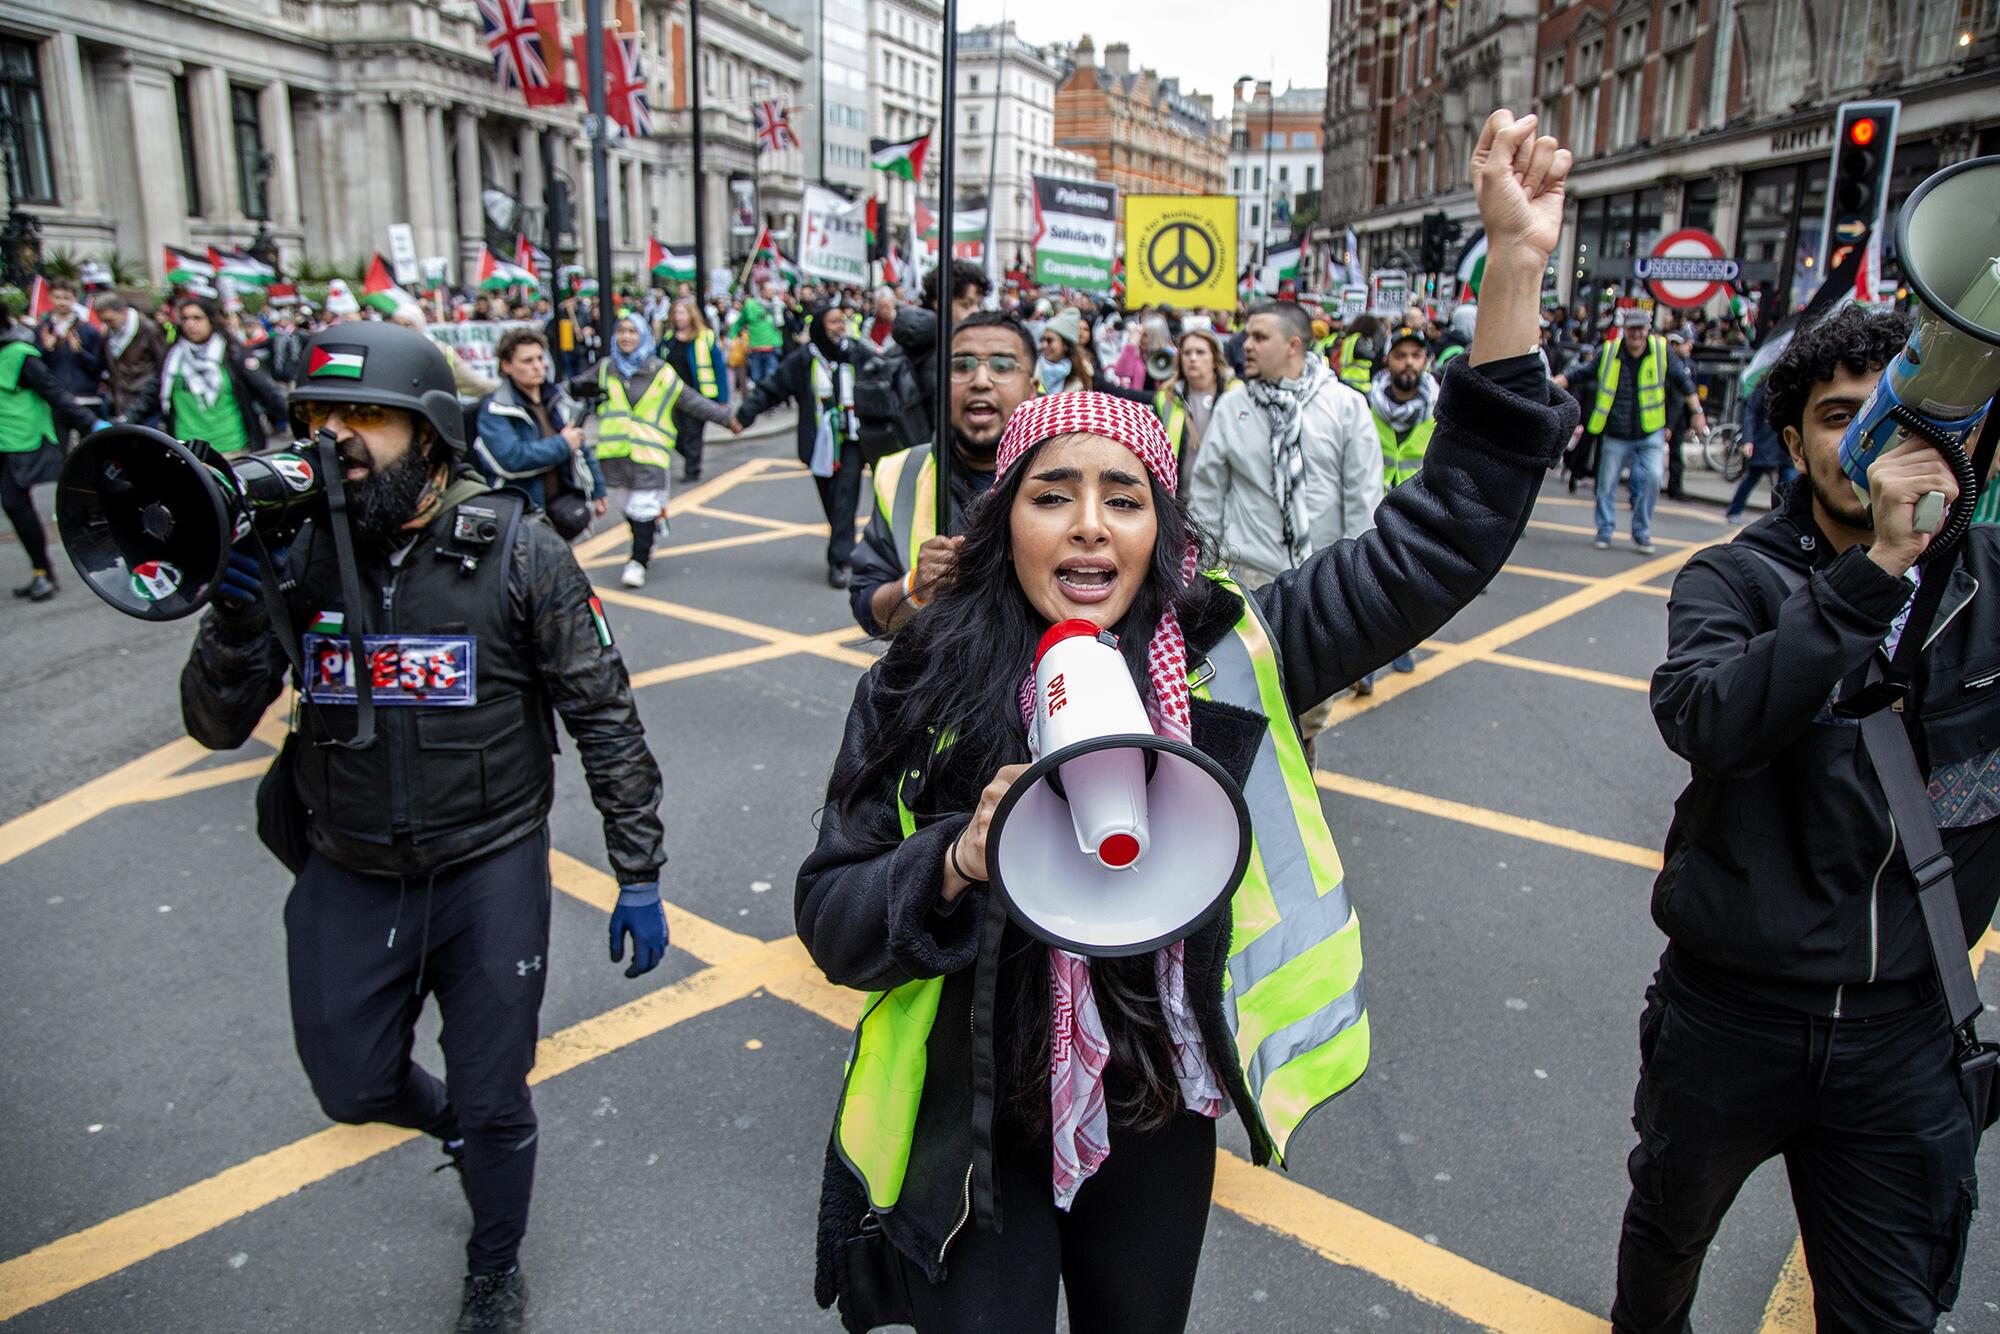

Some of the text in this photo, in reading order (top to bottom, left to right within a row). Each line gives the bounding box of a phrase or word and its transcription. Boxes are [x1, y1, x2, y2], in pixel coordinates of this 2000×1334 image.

[1055, 186, 1109, 211] Palestine
[1050, 224, 1107, 248] Solidarity
[1043, 258, 1108, 282] Campaign
[1634, 259, 1739, 279] UNDERGROUND
[1047, 673, 1067, 718] PYLE
